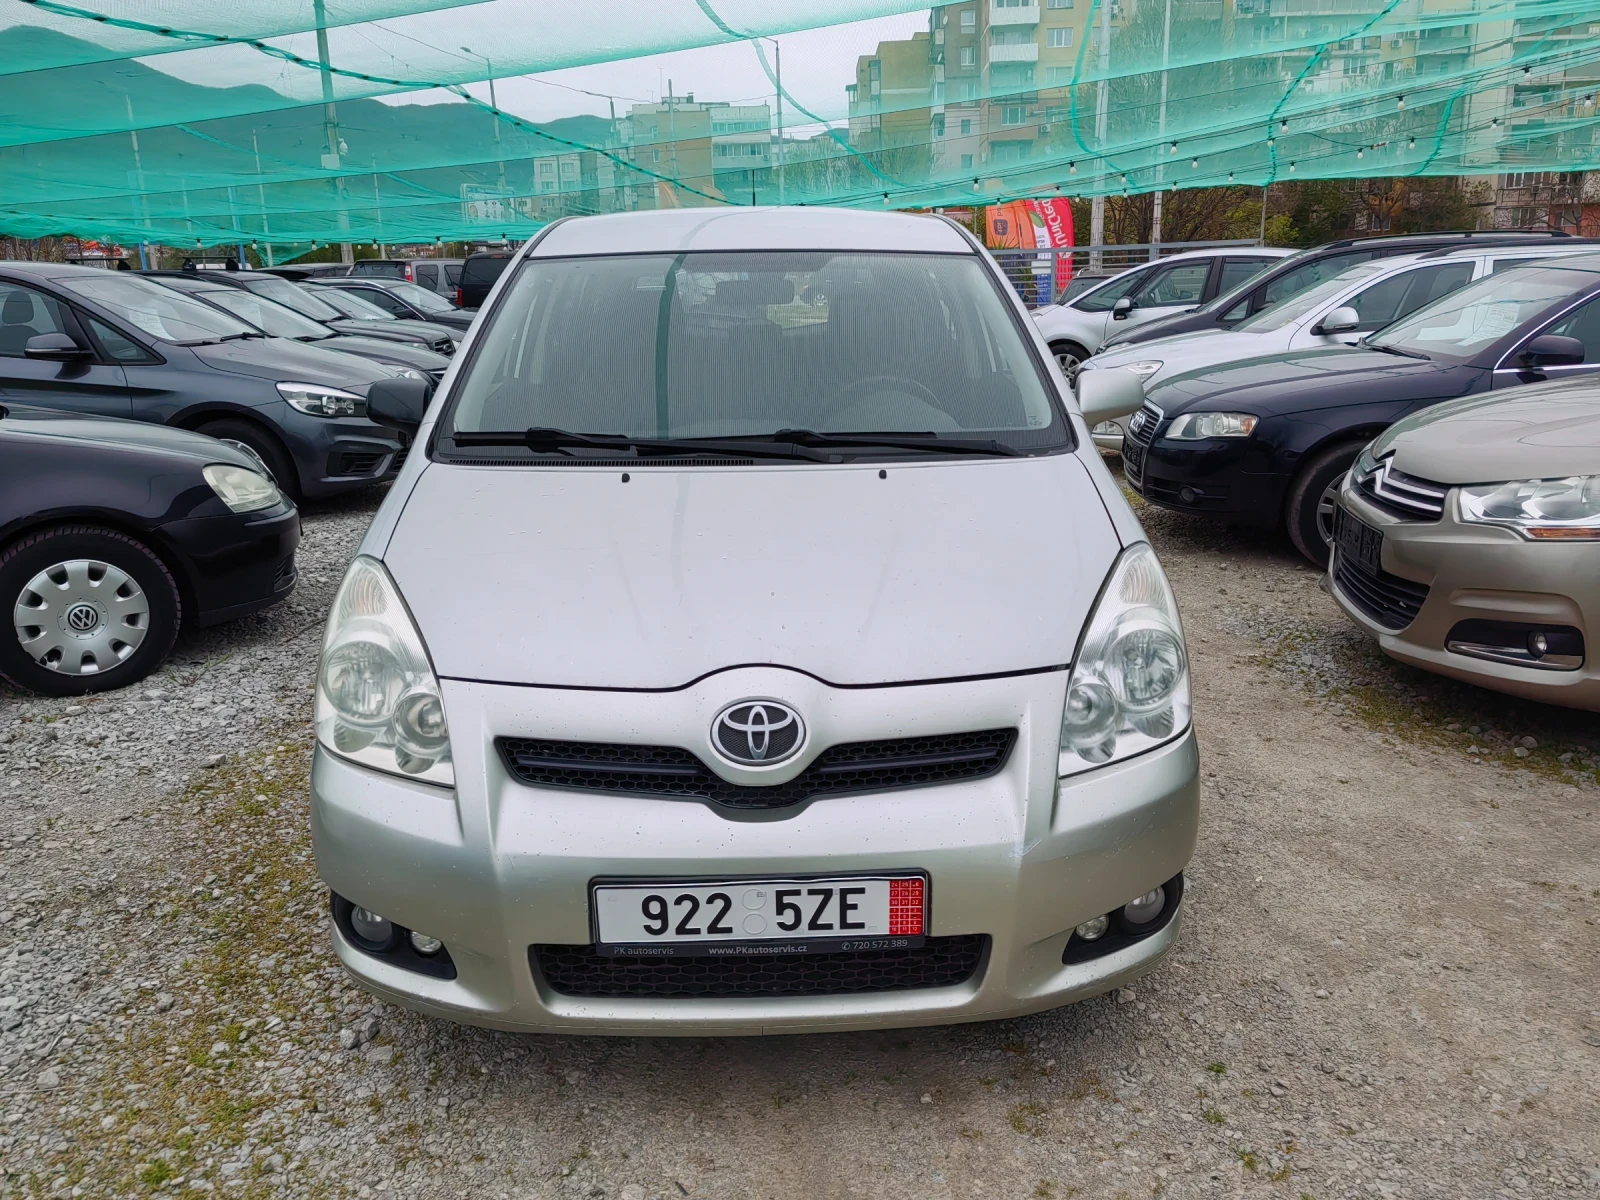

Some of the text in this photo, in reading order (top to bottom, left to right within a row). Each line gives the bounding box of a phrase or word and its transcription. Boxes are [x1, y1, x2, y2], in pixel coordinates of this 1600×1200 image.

[641, 887, 866, 935] 922 5ZE
[708, 944, 808, 955] www.PKautoservis.cz
[852, 939, 908, 950] 720 572 389
[613, 946, 674, 955] PK autoservis
